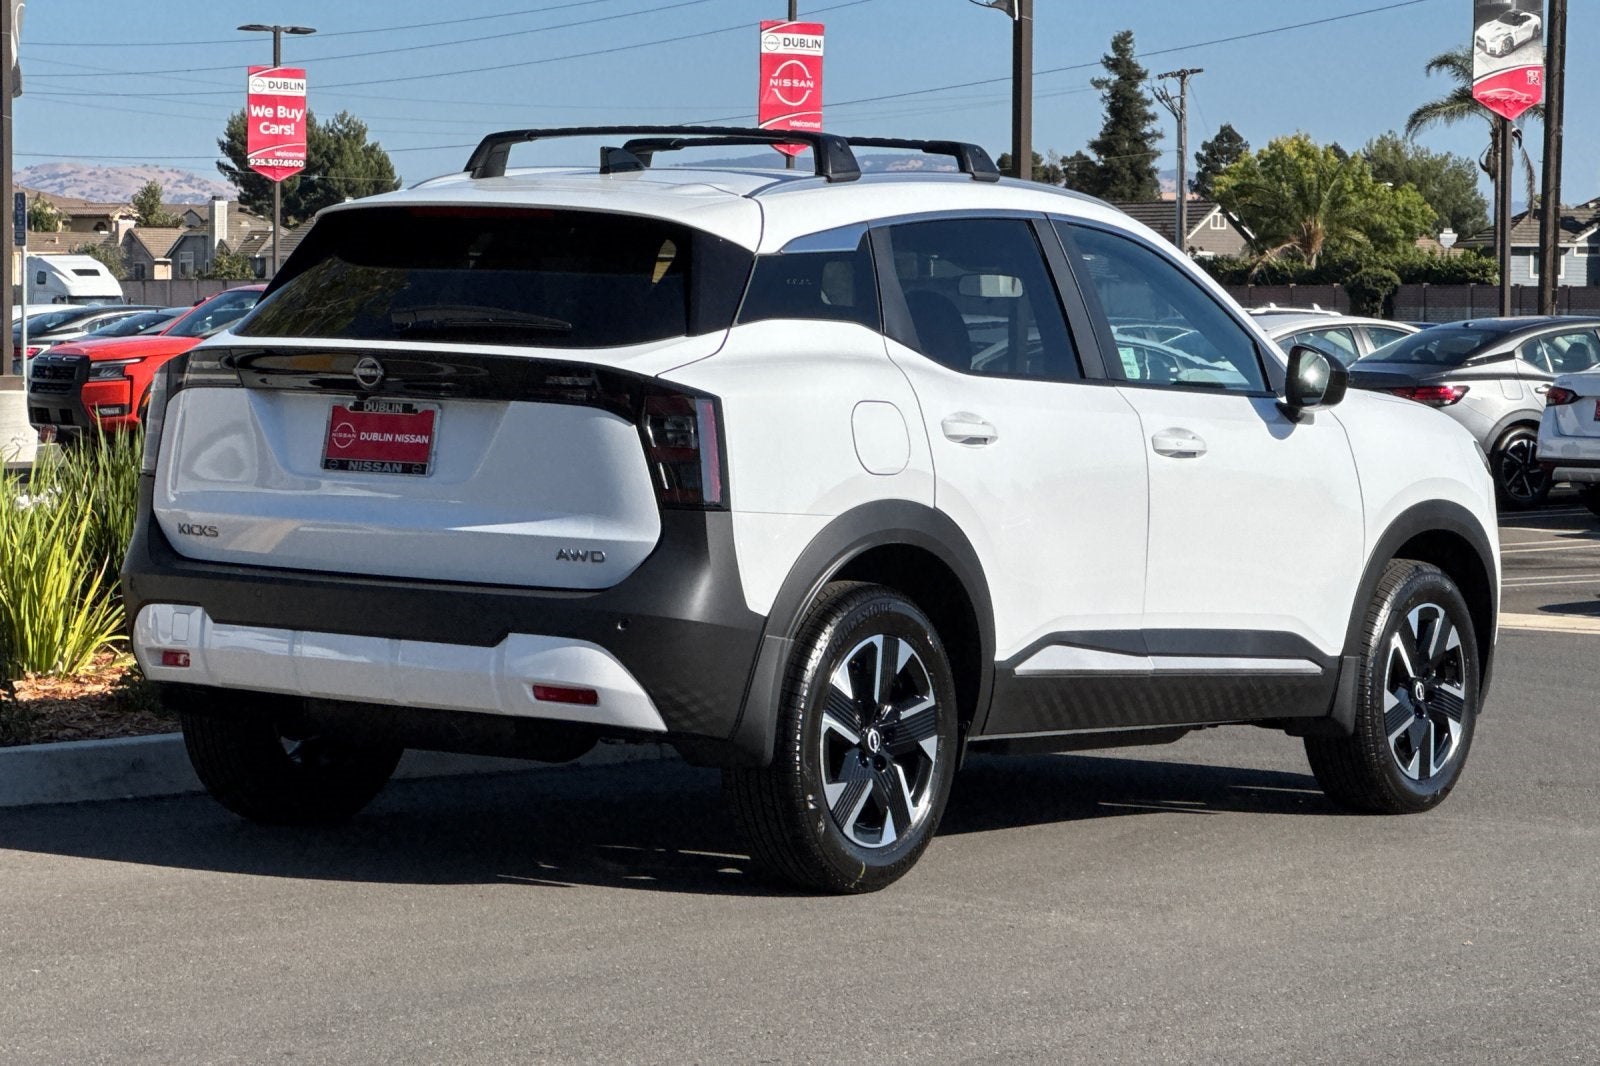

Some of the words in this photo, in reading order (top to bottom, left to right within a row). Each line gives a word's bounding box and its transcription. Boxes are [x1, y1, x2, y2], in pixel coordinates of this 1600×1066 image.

[783, 37, 822, 49] DUBLIN
[268, 80, 304, 90] DUBLIN
[769, 78, 814, 88] NISSAN
[250, 104, 274, 118] We
[277, 105, 304, 122] Buy
[259, 121, 295, 136] Cars!
[789, 119, 821, 129] Welcome!
[363, 402, 403, 413] DUBLIN
[360, 432, 393, 442] DUBLIN
[394, 434, 429, 444] NISSAN
[348, 461, 402, 473] NISSAN
[177, 522, 219, 538] KICKS
[555, 548, 606, 563] AWD
